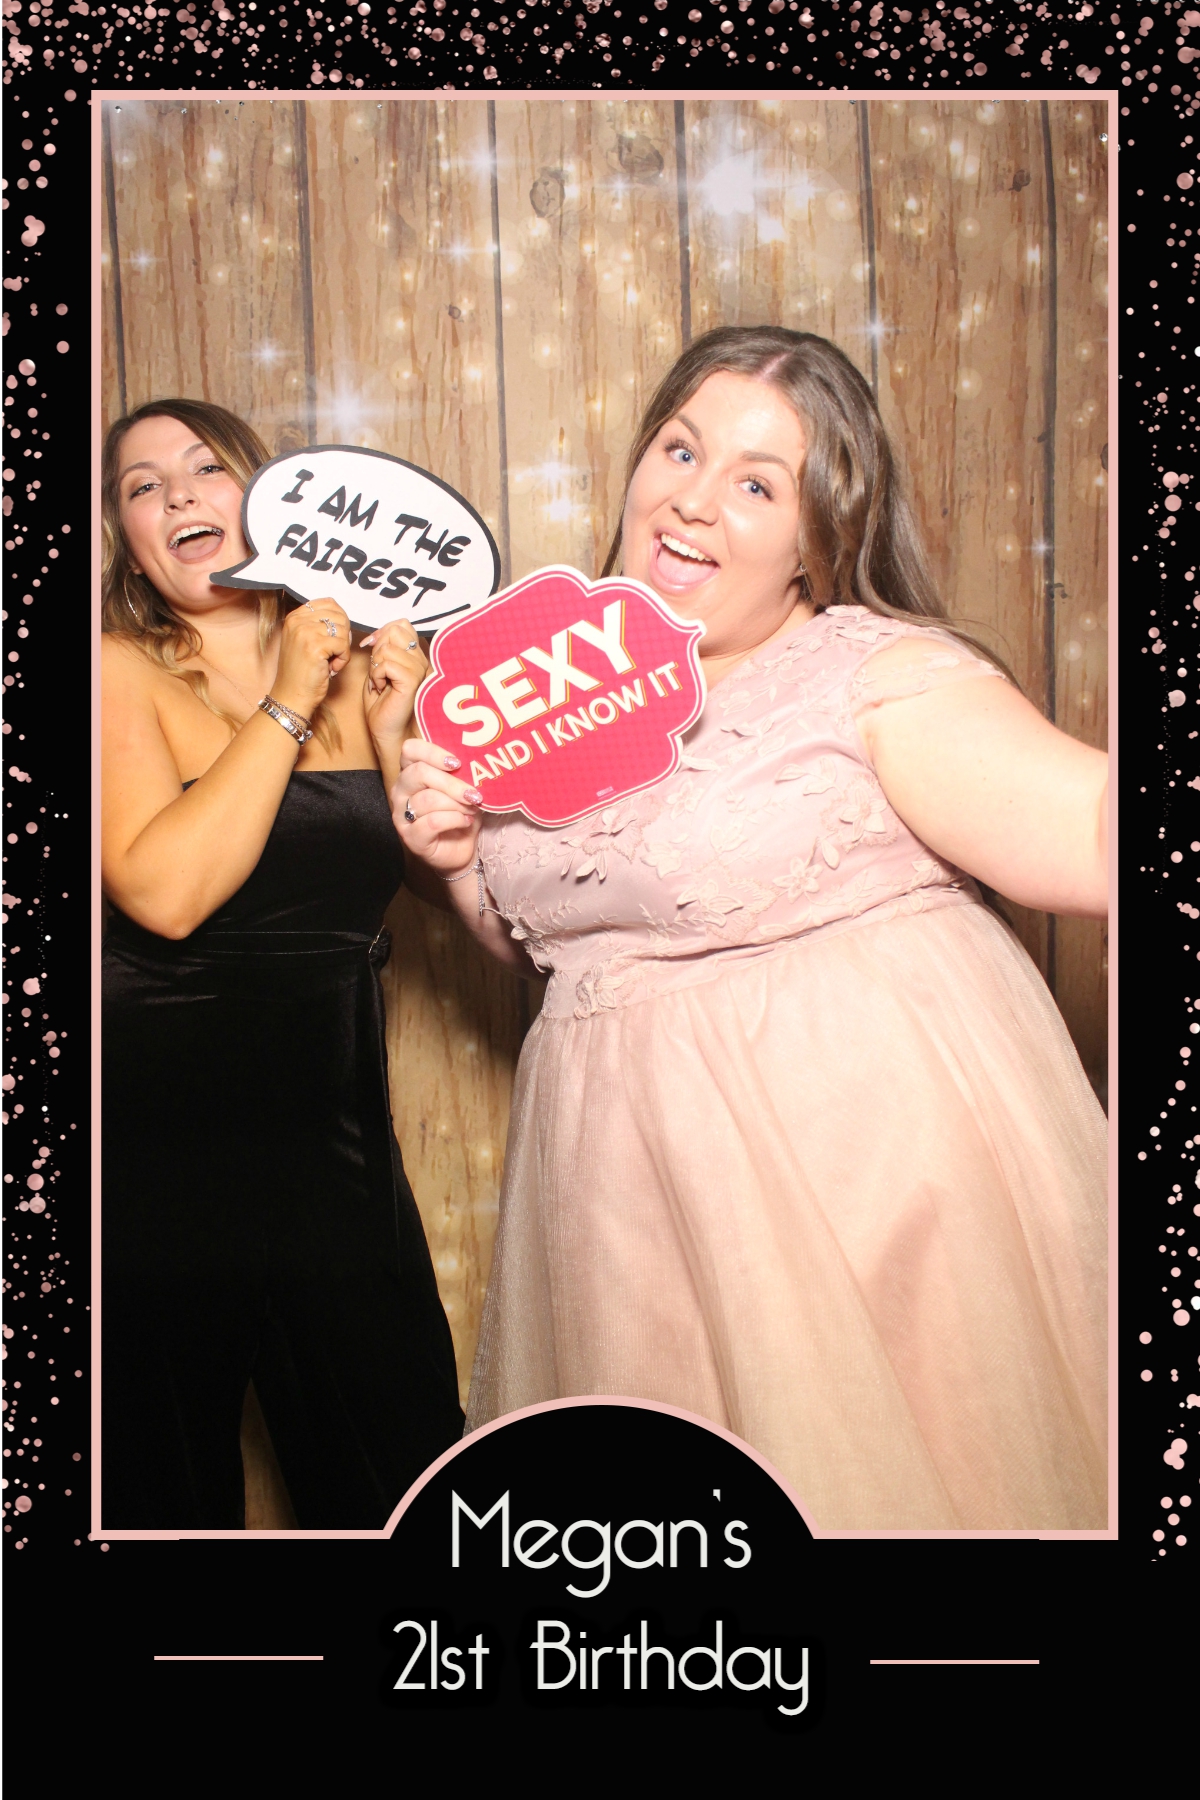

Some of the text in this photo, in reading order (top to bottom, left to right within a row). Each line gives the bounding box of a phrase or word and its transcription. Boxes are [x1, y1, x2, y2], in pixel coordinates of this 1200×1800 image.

[275, 523, 447, 608] FAIREST
[281, 468, 471, 567] I AM THE
[442, 599, 637, 748] SEXY
[469, 661, 683, 787] AND I KNOW IT
